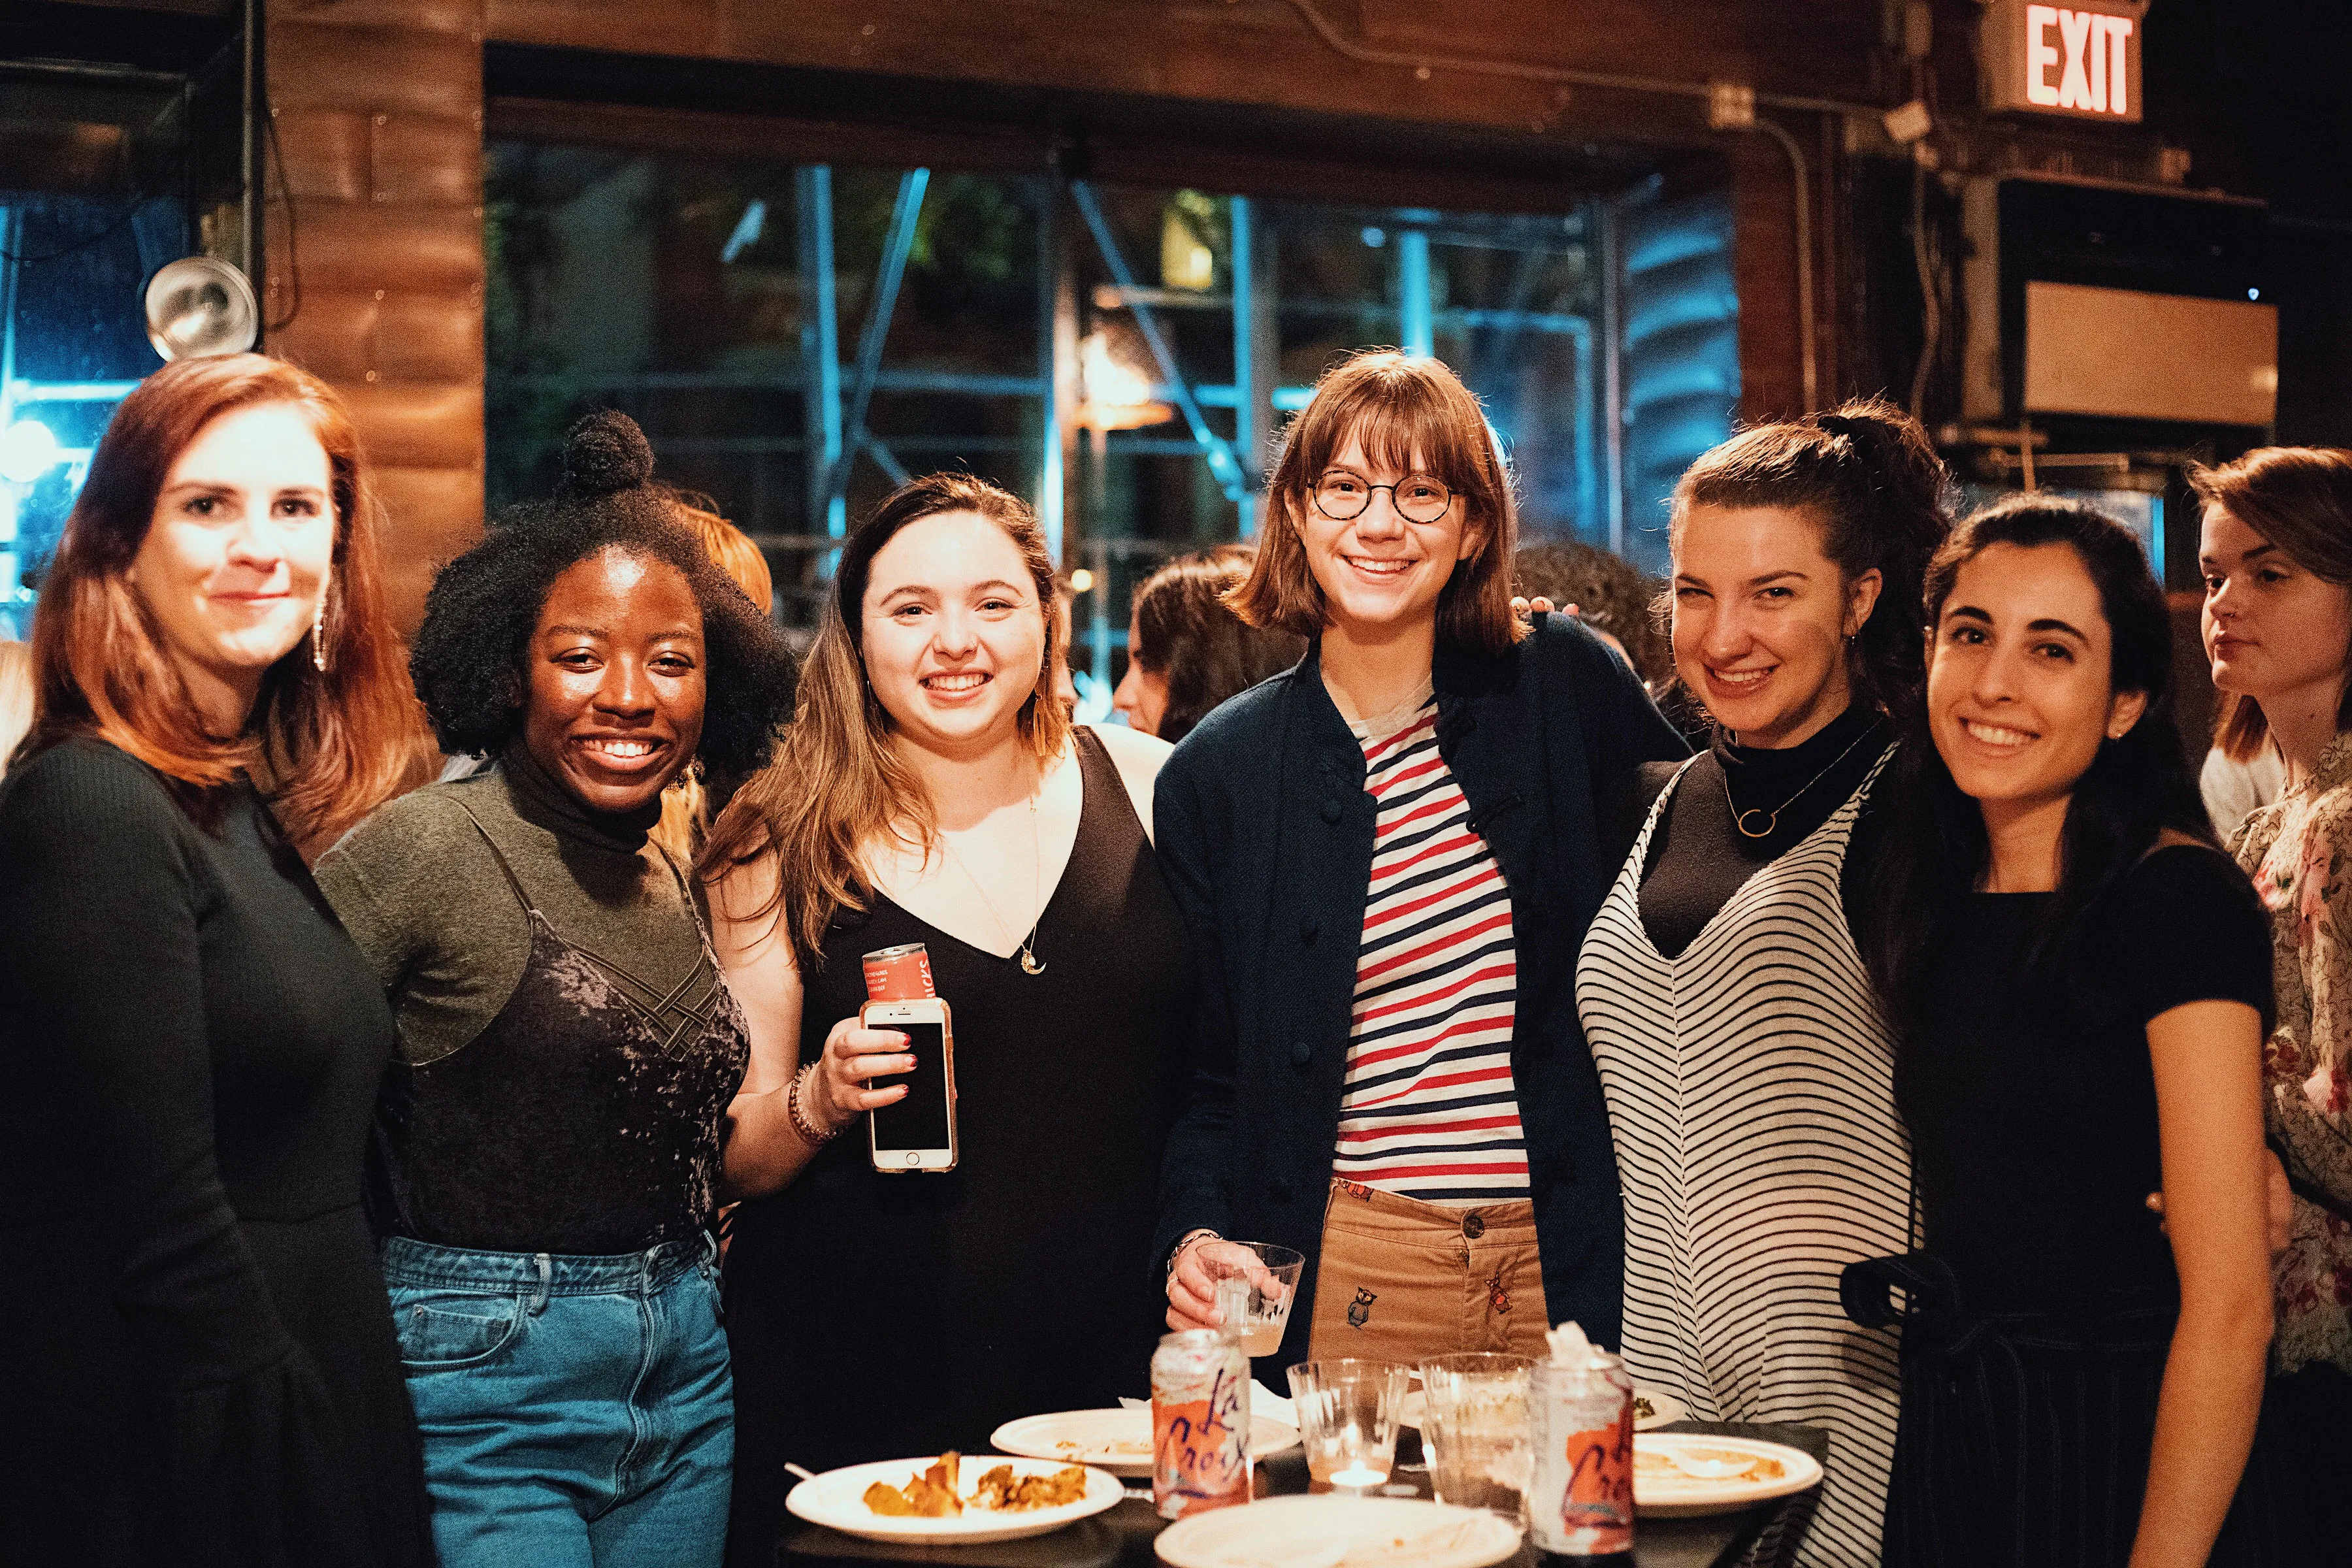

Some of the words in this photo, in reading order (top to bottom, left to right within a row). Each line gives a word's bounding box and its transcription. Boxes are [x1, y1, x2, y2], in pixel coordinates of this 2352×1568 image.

[2027, 4, 2133, 115] EXIT
[1197, 1368, 1240, 1436] La
[1157, 1416, 1250, 1499] Croix
